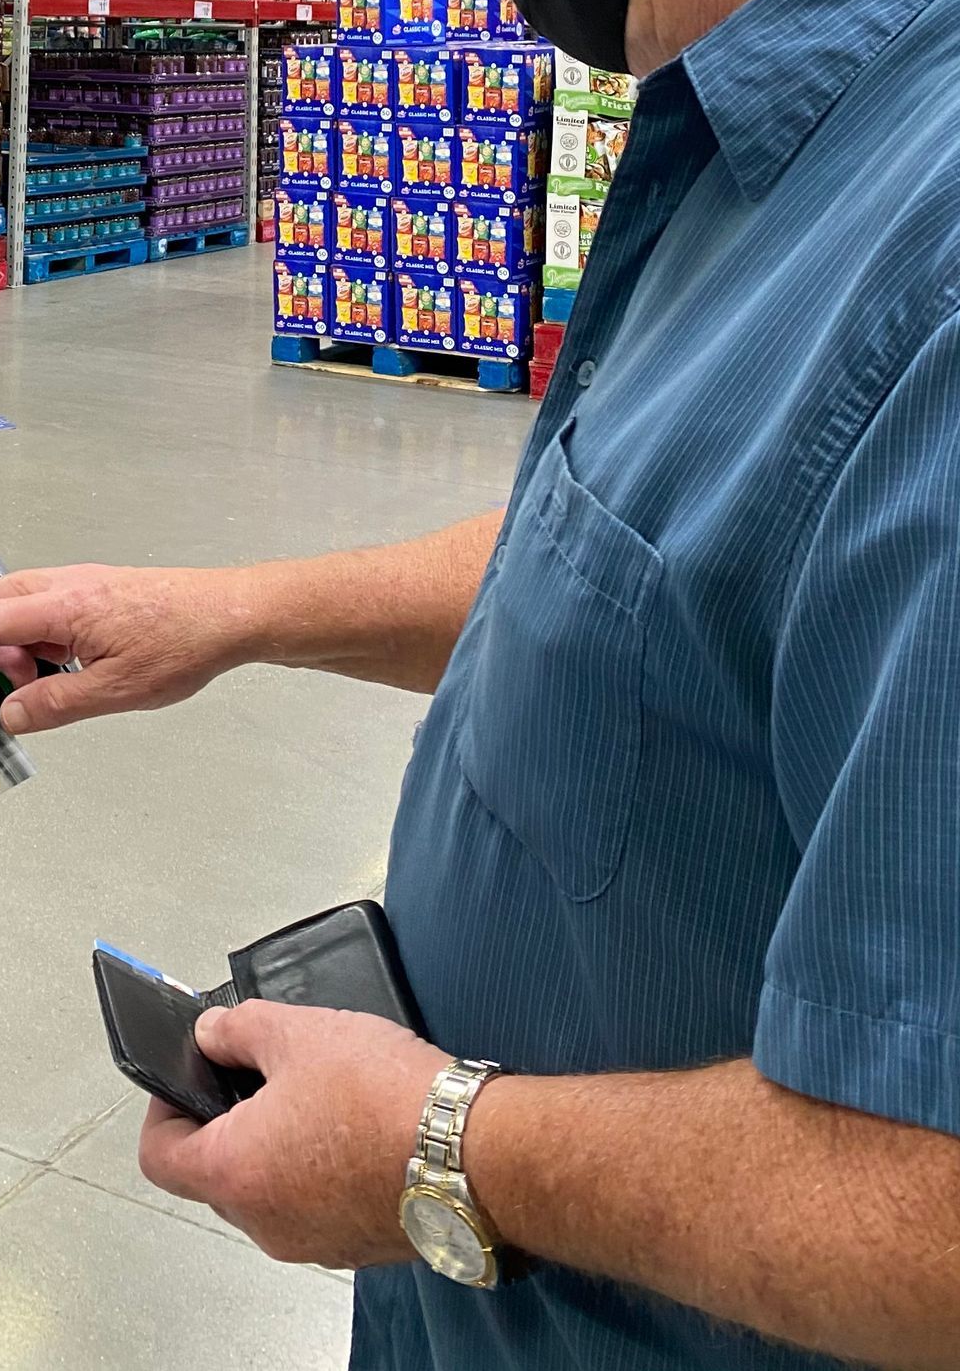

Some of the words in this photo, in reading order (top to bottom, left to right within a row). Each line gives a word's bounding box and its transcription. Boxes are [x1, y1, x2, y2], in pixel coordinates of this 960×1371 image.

[601, 97, 631, 111] Fried
[556, 116, 585, 124] Limited
[549, 203, 577, 211] Limited
